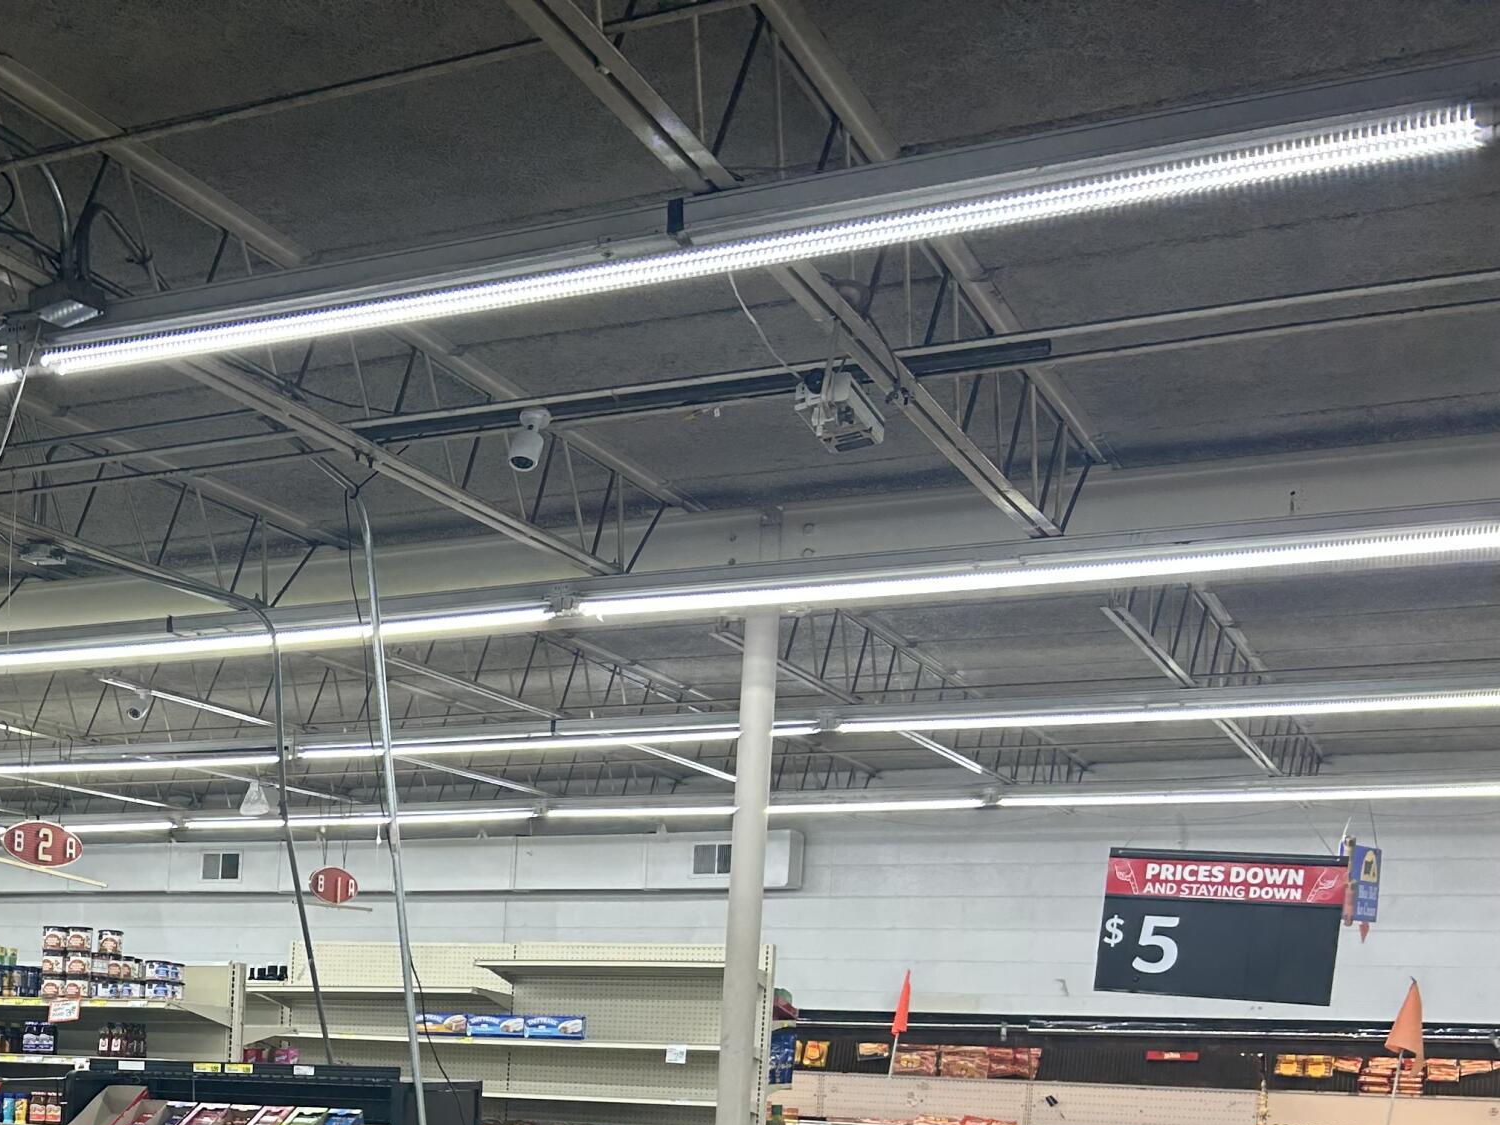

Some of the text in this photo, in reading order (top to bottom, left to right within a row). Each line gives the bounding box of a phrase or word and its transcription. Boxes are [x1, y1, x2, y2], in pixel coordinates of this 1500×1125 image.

[14, 828, 76, 861] B 2 A
[317, 874, 325, 892] B
[348, 879, 355, 896] A
[1145, 863, 1305, 886] PRICES DOWN
[1142, 882, 1303, 900] AND STAYING DOWN
[1103, 914, 1180, 974] $ 5
